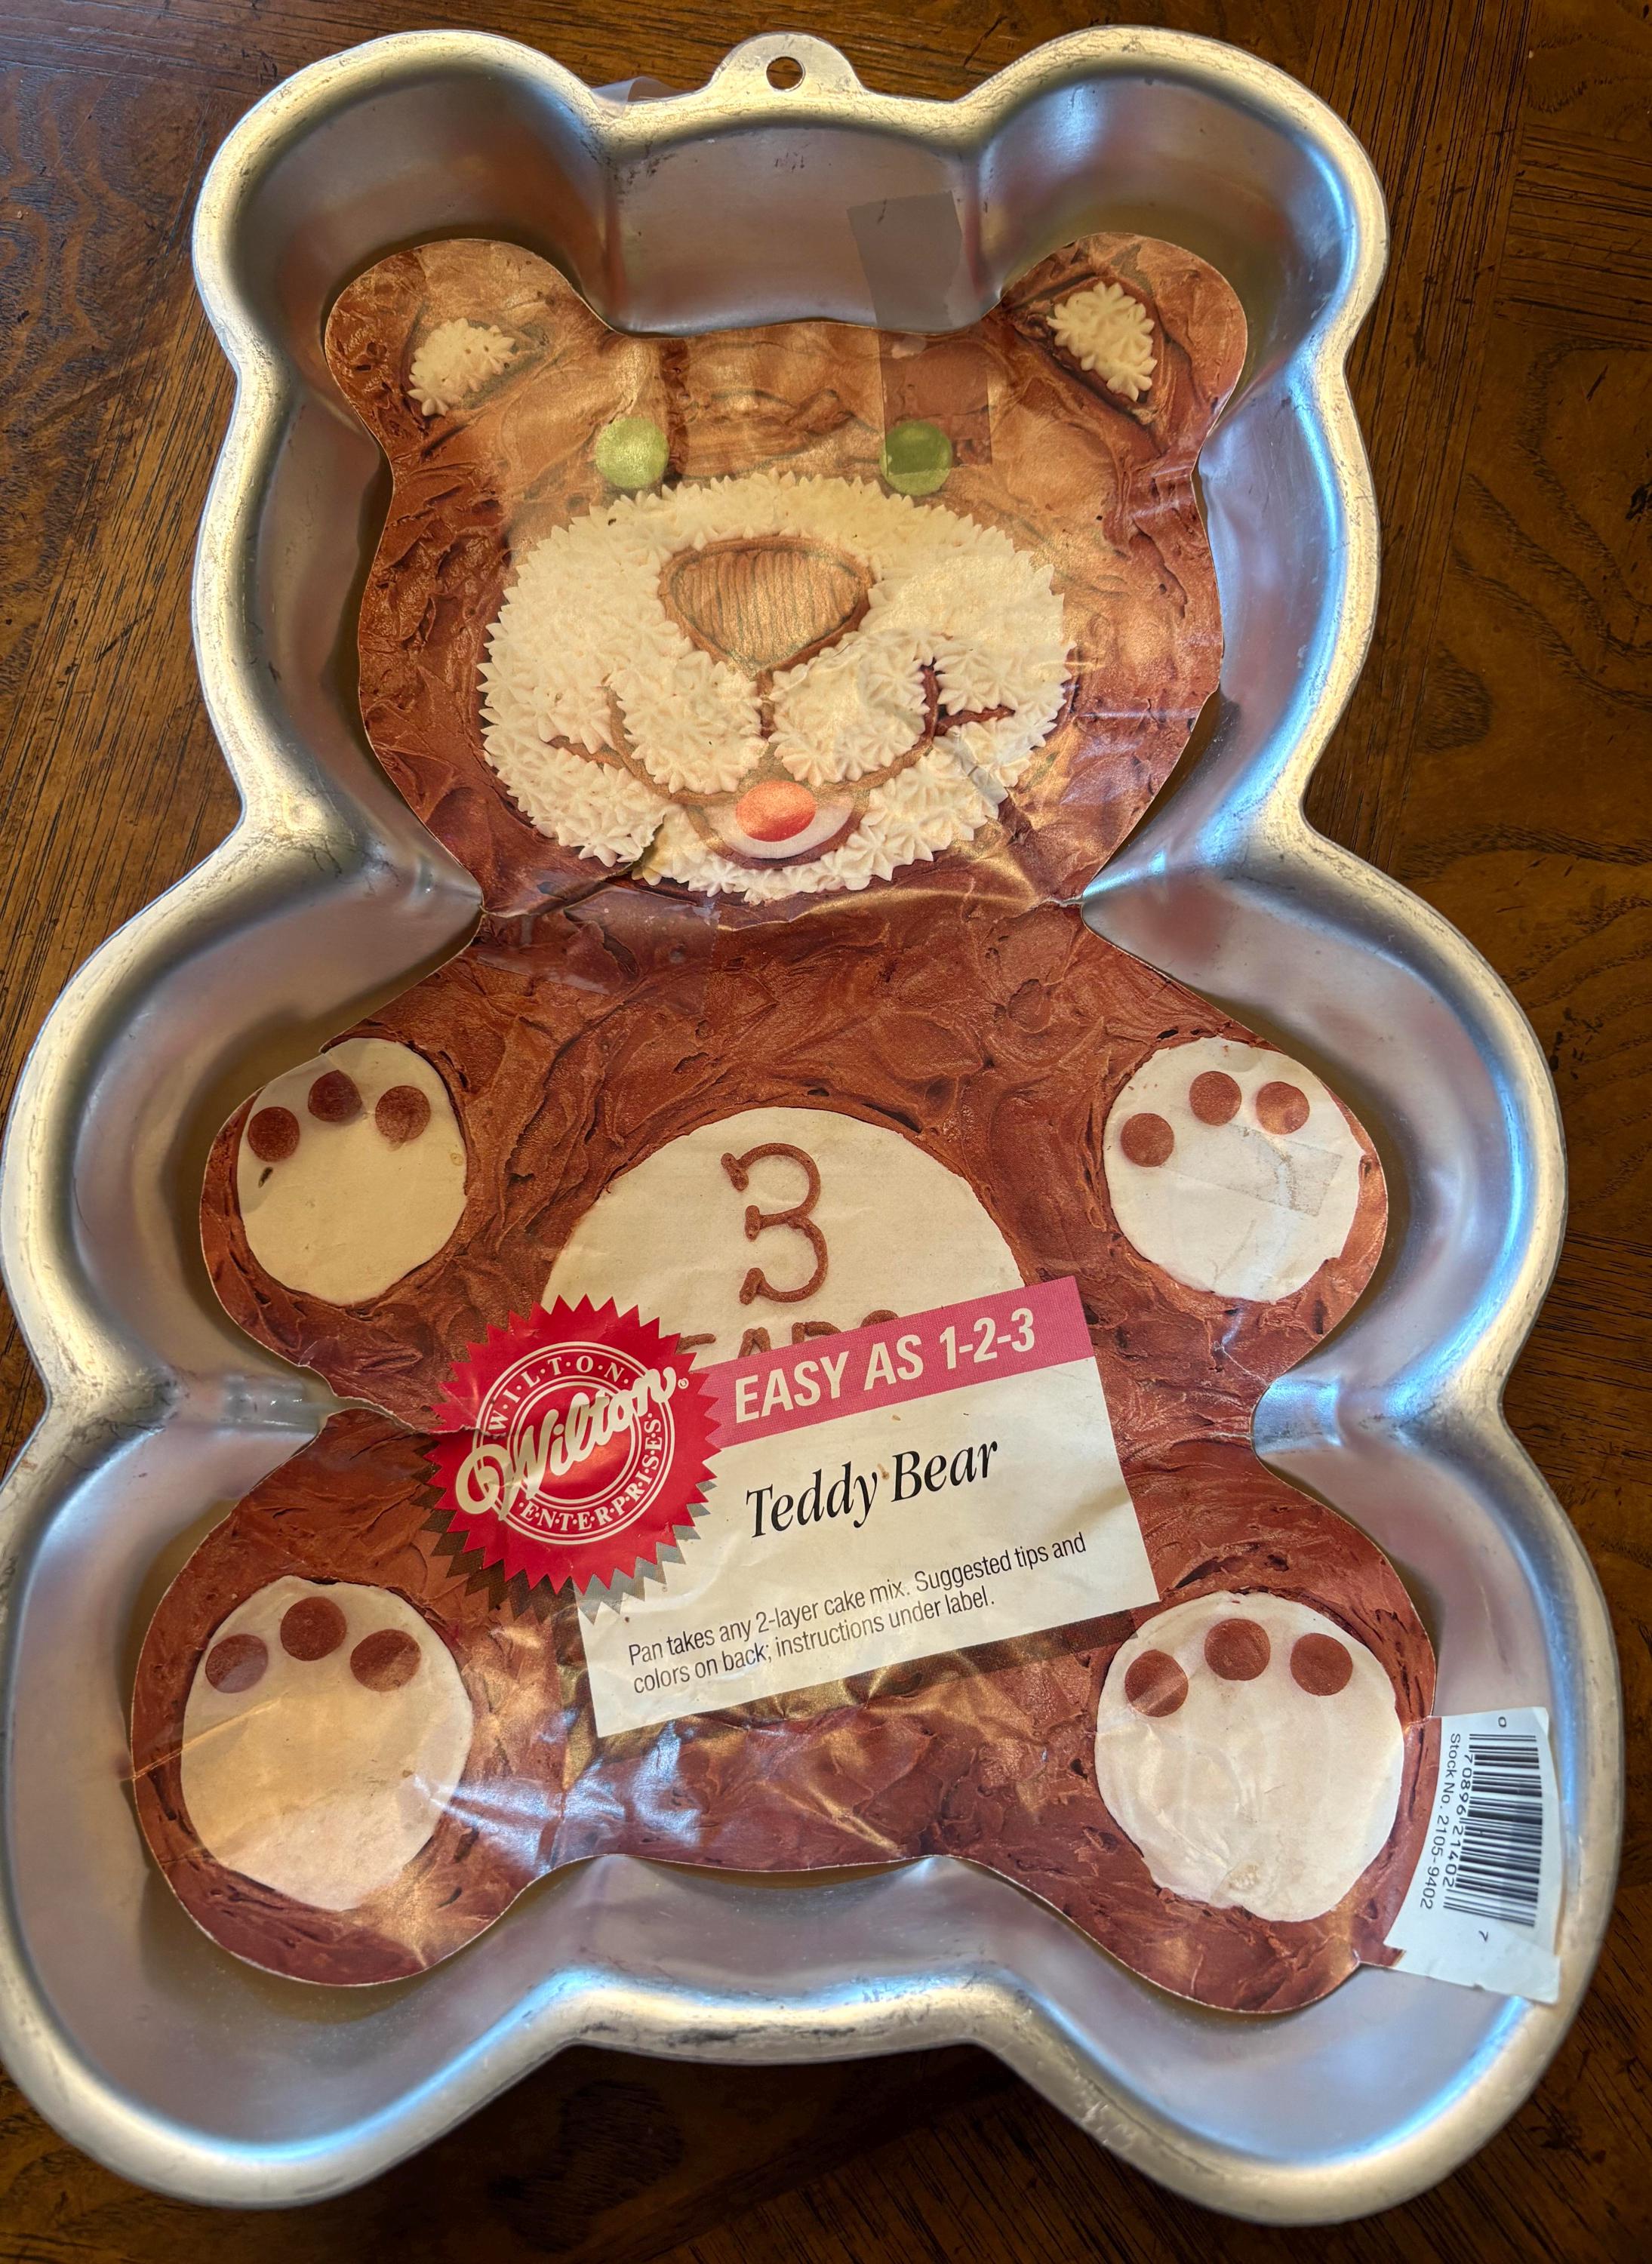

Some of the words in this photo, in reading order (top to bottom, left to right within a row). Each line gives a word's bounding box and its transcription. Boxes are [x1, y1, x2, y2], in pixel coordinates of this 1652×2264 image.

[721, 1142, 828, 1305] 3
[735, 1351, 849, 1423] EASY
[863, 1334, 924, 1391] AS
[939, 1308, 1035, 1370] 1-2-3
[746, 1461, 878, 1538] Teddy
[891, 1441, 998, 1503] Bear
[629, 1643, 663, 1666] Pan
[667, 1630, 715, 1655] takes
[719, 1620, 751, 1641] any
[755, 1601, 819, 1632] 2-layer
[824, 1590, 866, 1616] cake
[869, 1579, 910, 1604] mix.
[915, 1549, 1012, 1591] Suggested
[1014, 1546, 1049, 1570] tips
[1053, 1531, 1086, 1558] and
[634, 1665, 691, 1693] colors
[695, 1659, 718, 1678] on
[721, 1642, 772, 1672] back;
[776, 1616, 884, 1657] instructions
[889, 1600, 941, 1628] under
[945, 1586, 995, 1615] label.
[1444, 1733, 1461, 1778] Stock
[1497, 1715, 1507, 1728] 0
[1440, 1782, 1456, 1810] No.
[1456, 1755, 1474, 1816] 70896
[1420, 1814, 1450, 1909] 2105-9402
[1442, 1825, 1464, 1888] 21402
